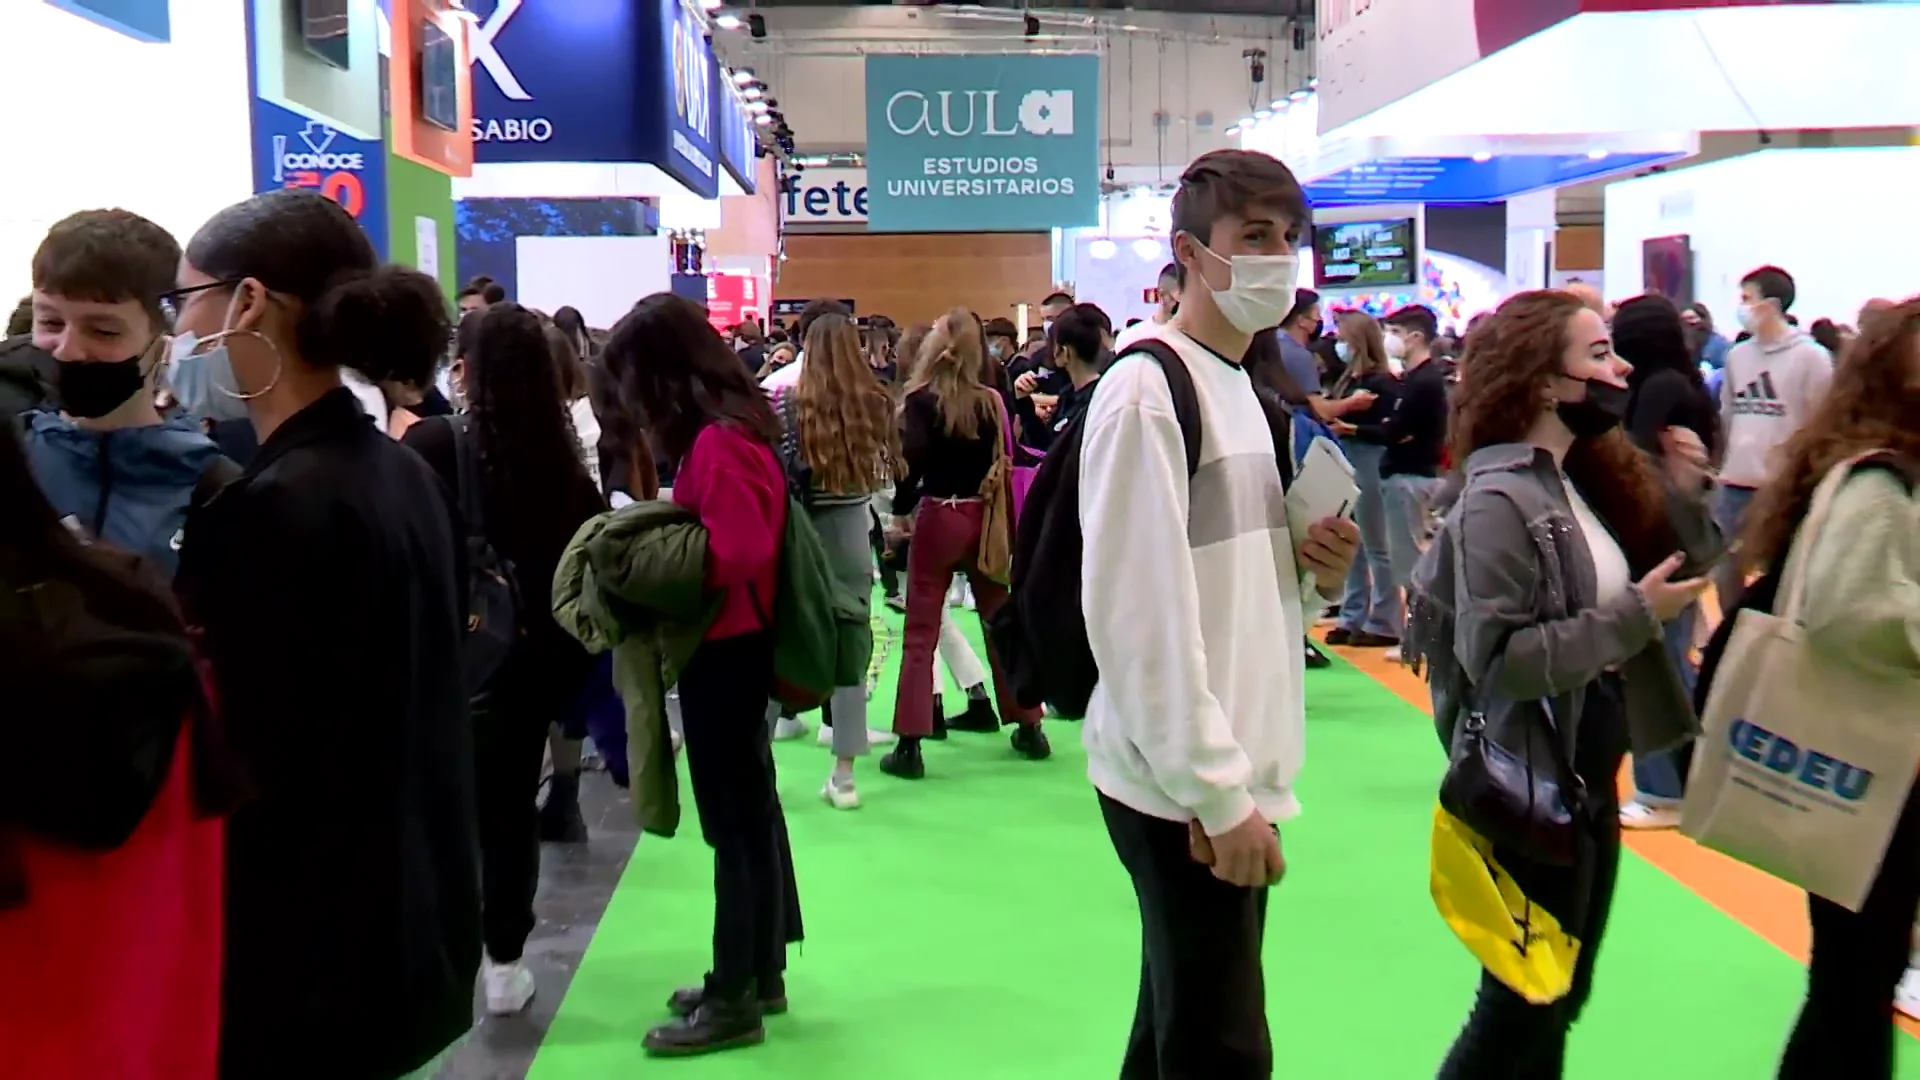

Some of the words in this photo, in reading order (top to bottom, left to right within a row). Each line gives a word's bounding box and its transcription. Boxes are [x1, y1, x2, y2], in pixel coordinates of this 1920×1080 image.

[471, 117, 552, 142] SABIO
[283, 152, 364, 170] CONOCE
[923, 156, 1038, 175] ESTUDIOS
[887, 177, 1074, 196] UNIVERSITARIOS
